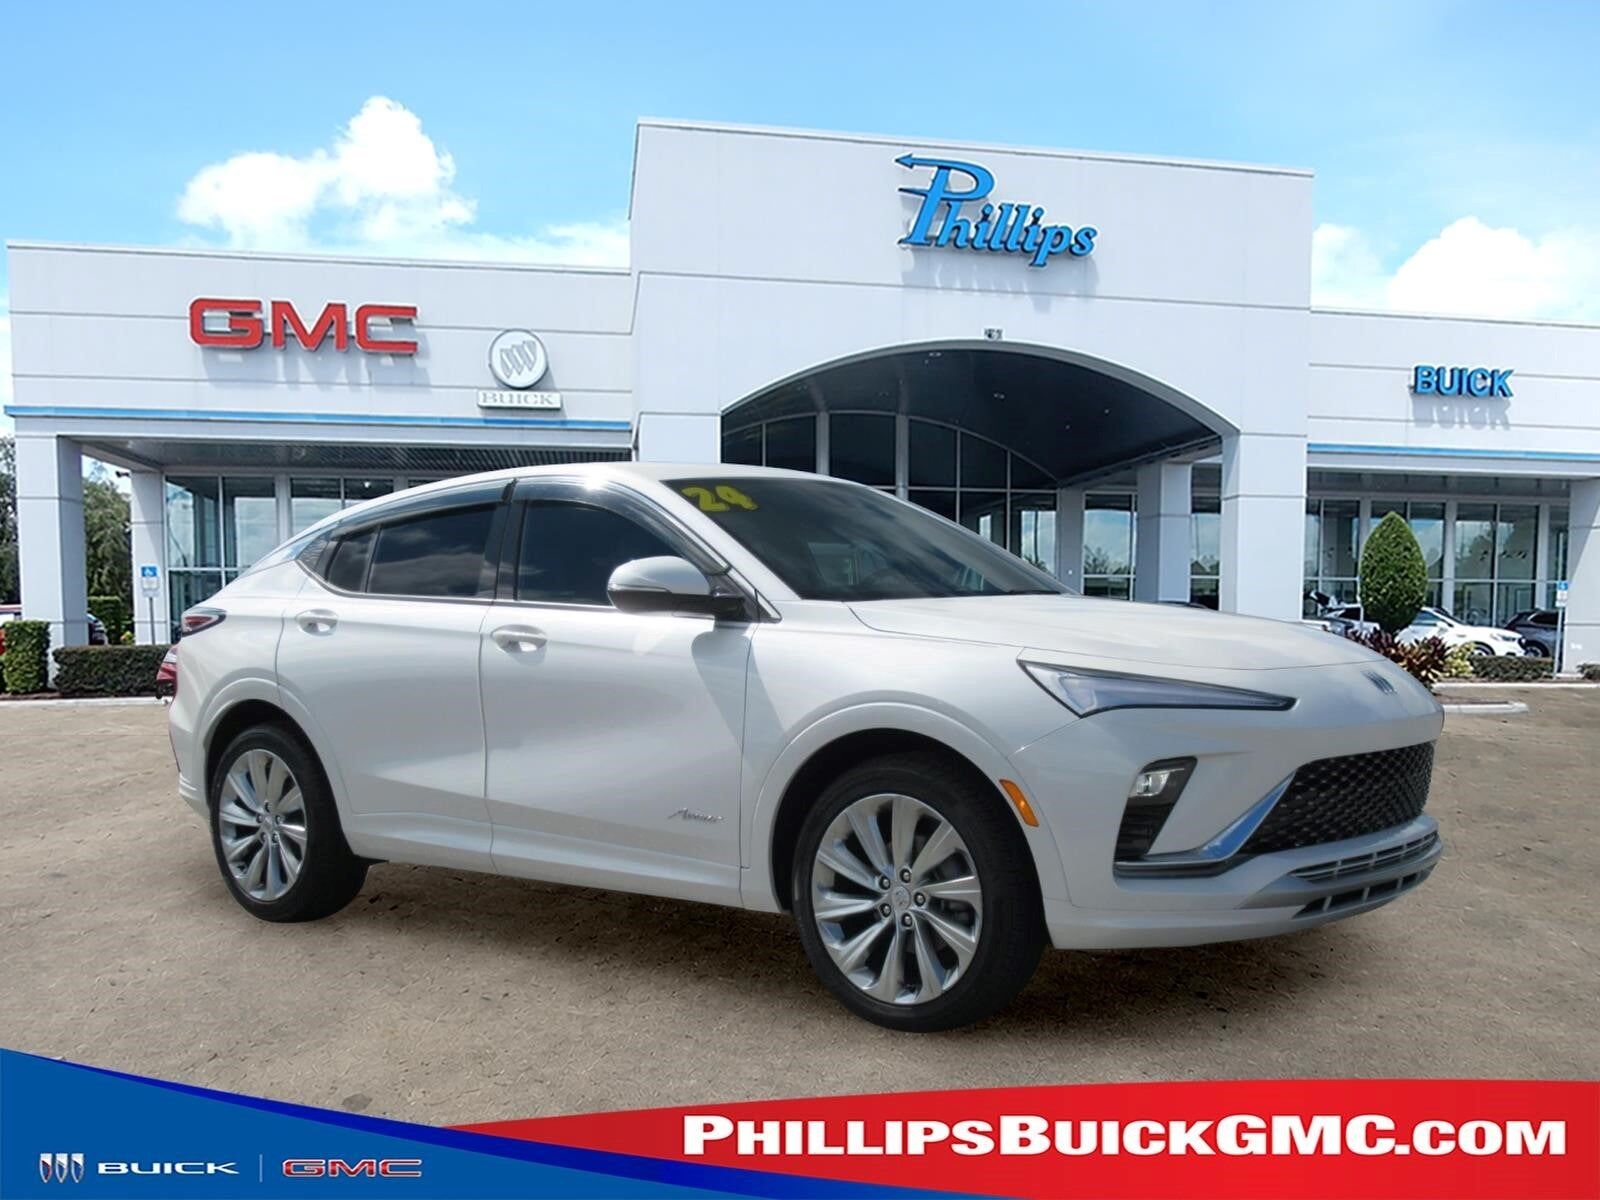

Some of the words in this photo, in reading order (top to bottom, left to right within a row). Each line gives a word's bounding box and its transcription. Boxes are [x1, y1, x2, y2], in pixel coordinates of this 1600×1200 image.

[895, 153, 1098, 267] Phillips
[189, 298, 417, 353] GMC
[1414, 365, 1514, 398] BUICK
[482, 392, 554, 405] BUICK
[681, 485, 758, 512] 24
